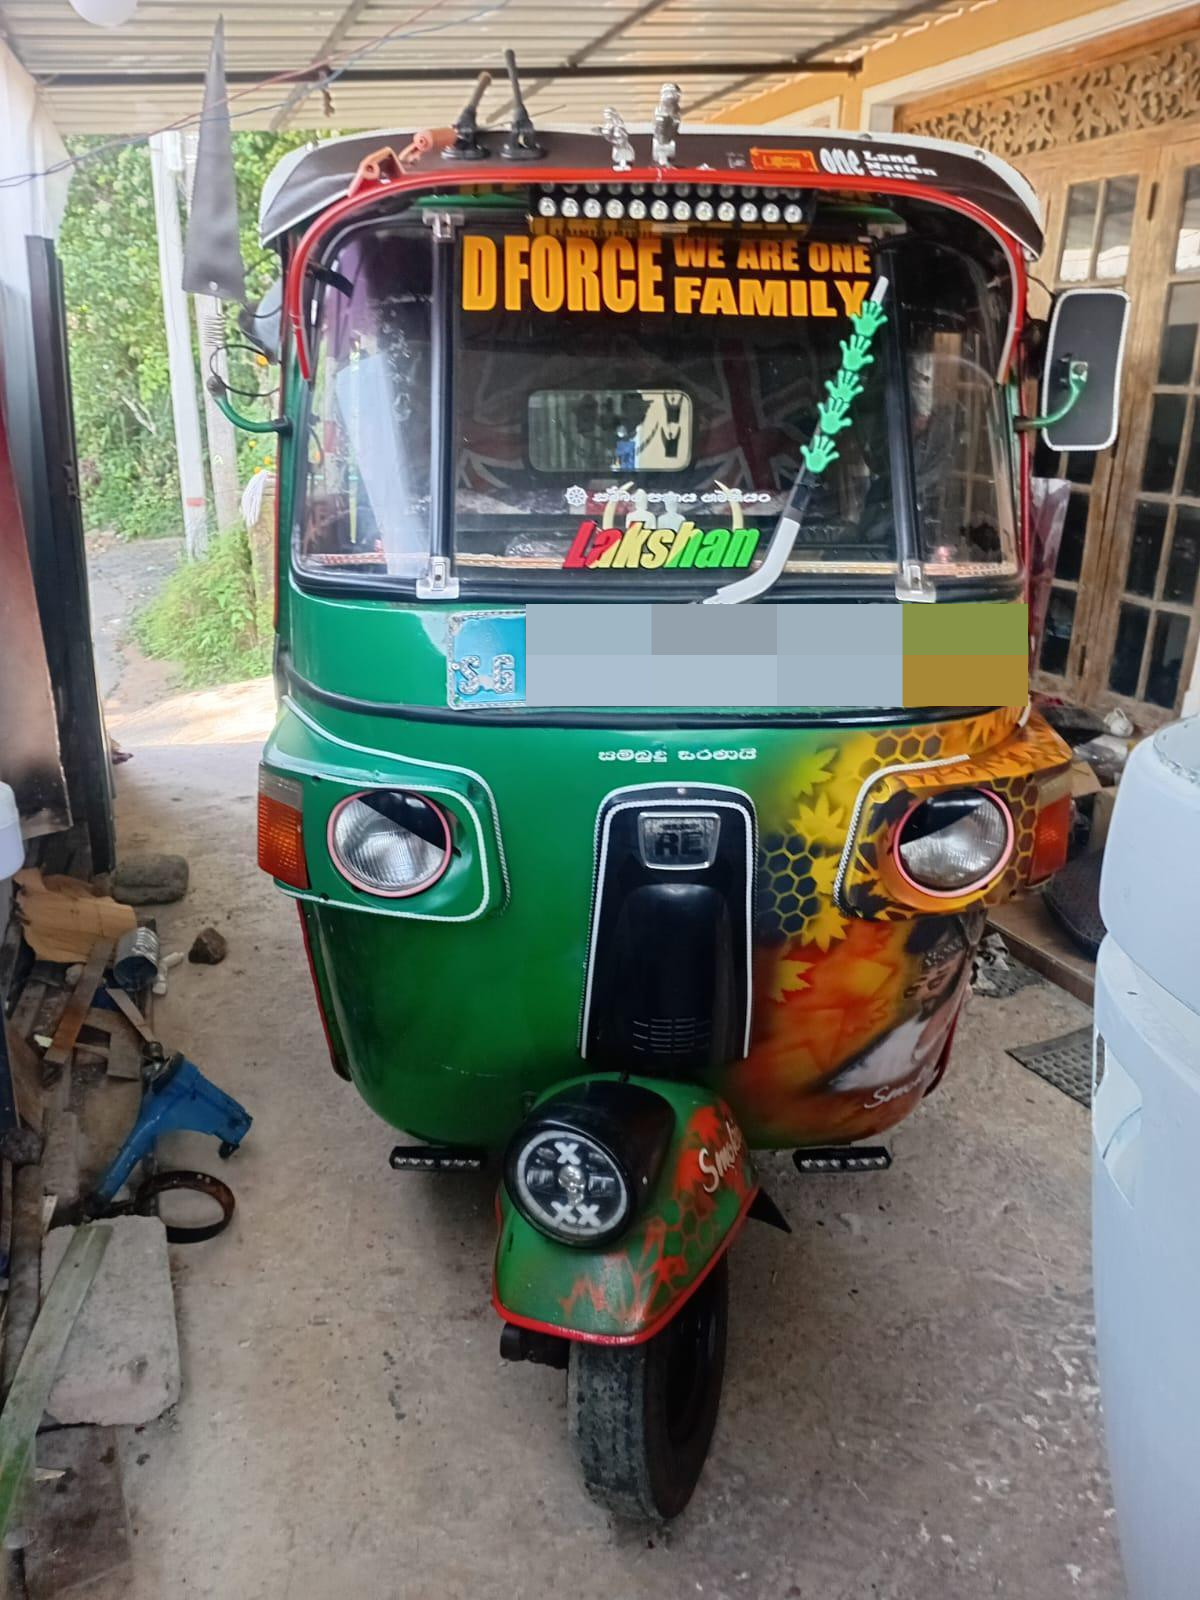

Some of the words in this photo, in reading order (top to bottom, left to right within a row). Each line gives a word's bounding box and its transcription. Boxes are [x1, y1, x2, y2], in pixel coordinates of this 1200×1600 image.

[862, 150, 918, 165] Land
[865, 162, 938, 177] Nation
[674, 236, 725, 268] WE
[736, 238, 799, 271] ARE
[808, 242, 872, 274] ONE
[462, 235, 497, 312] D
[504, 235, 665, 313] FORCE
[674, 276, 870, 317] FAMILY
[562, 519, 761, 570] Lakshan
[677, 748, 757, 761] සරණයි
[656, 831, 703, 856] RE
